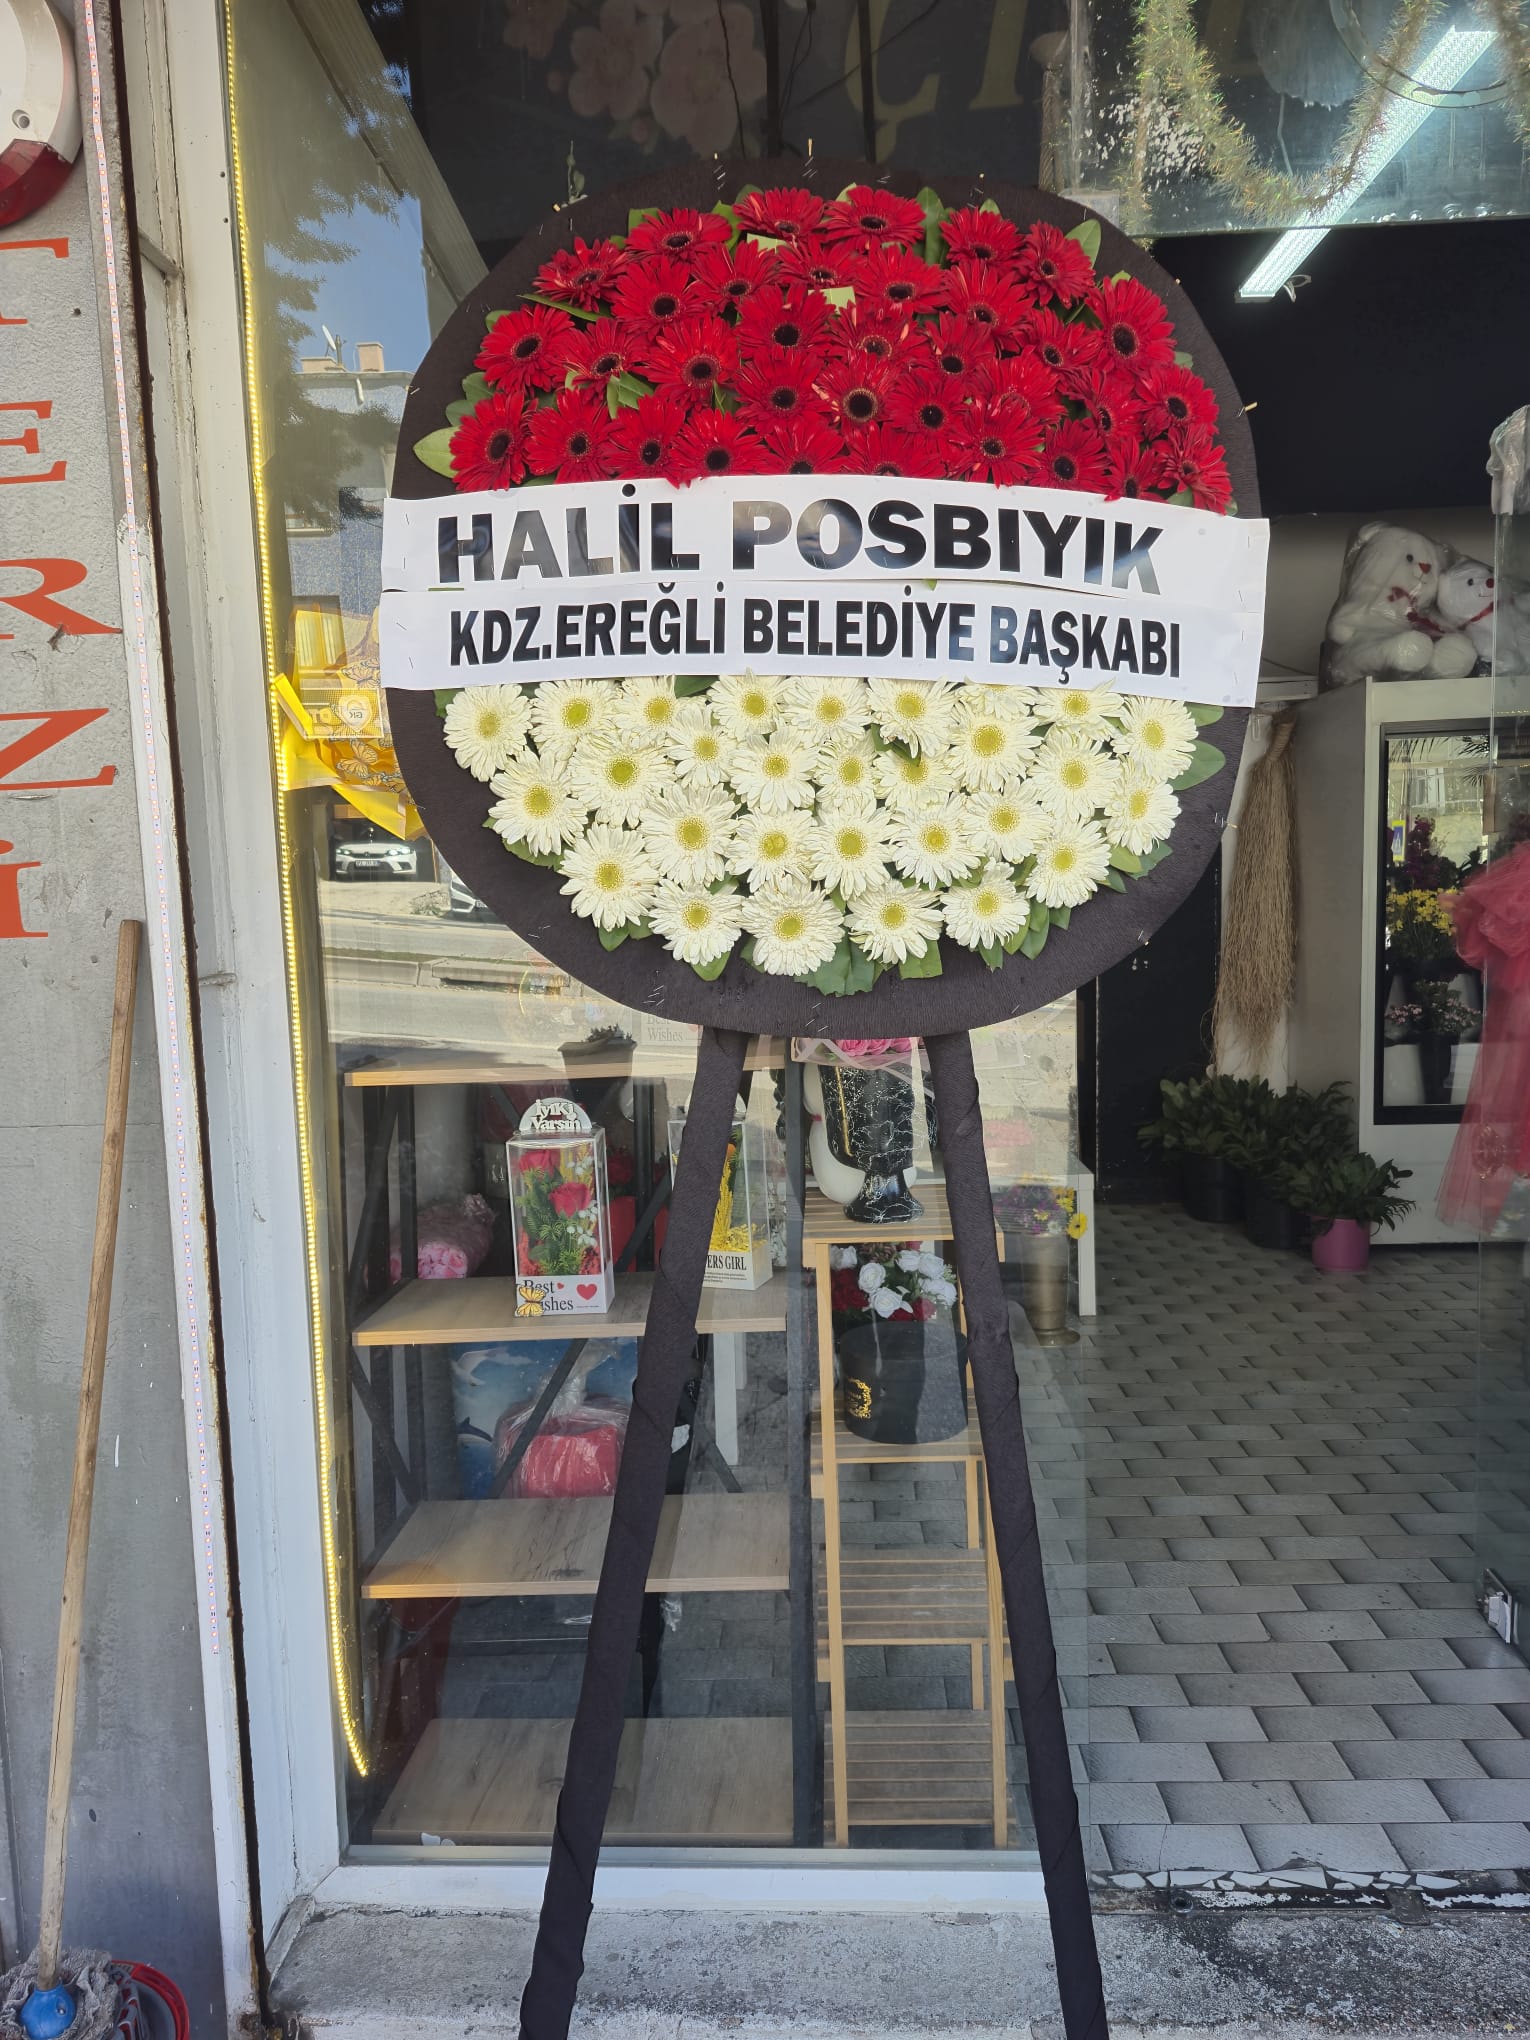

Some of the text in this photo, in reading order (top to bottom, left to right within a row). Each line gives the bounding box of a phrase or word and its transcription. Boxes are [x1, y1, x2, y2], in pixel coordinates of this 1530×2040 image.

[437, 483, 1164, 596] HALİL POSBIYIK
[450, 580, 1180, 685] KDZ.EREĞLİ BELEDİYE BAŞKABI
[725, 1255, 747, 1271] GIRL
[540, 1297, 574, 1311] ishes
